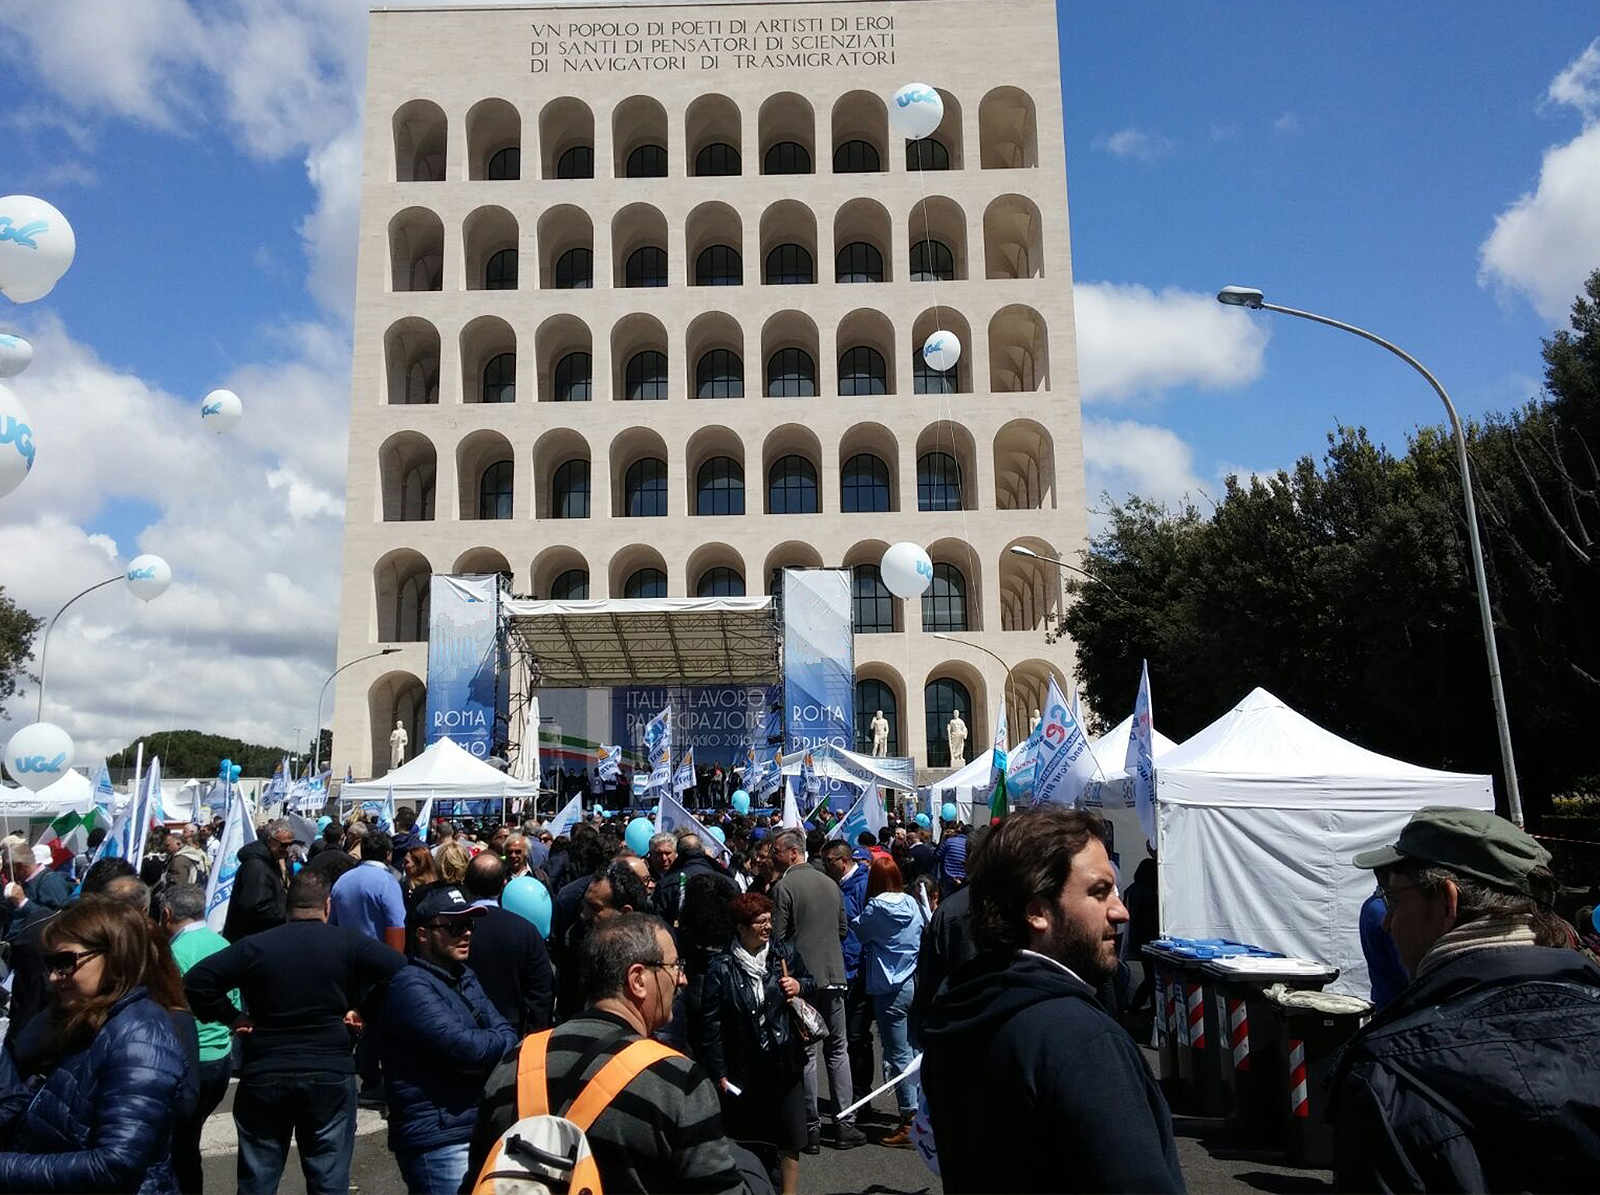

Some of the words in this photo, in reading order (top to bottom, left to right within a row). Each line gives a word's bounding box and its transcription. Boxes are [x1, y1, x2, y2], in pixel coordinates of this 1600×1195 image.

[531, 24, 561, 38] VN
[569, 22, 640, 37] POPOLO
[647, 22, 664, 36] DI
[671, 20, 722, 35] POETI
[729, 20, 747, 34] DI
[754, 18, 823, 34] ARTISTI
[831, 17, 848, 32] DI
[855, 16, 894, 31] EROI
[530, 41, 548, 56] DI
[558, 40, 616, 55] SANTI
[625, 39, 643, 54] DI
[651, 37, 757, 53] PENSATORI
[765, 36, 783, 51] DI
[791, 33, 895, 50] SCIENZIATI
[530, 58, 548, 73] DI
[563, 56, 686, 72] NAVIGATORI
[700, 55, 718, 70] DI
[733, 51, 896, 69] TRASMIGRATORI
[689, 689, 765, 708] LAVORO
[434, 709, 486, 727] ROMA
[793, 705, 845, 721] ROMA
[676, 735, 720, 747] MAGGIO
[724, 734, 752, 746] 2016
